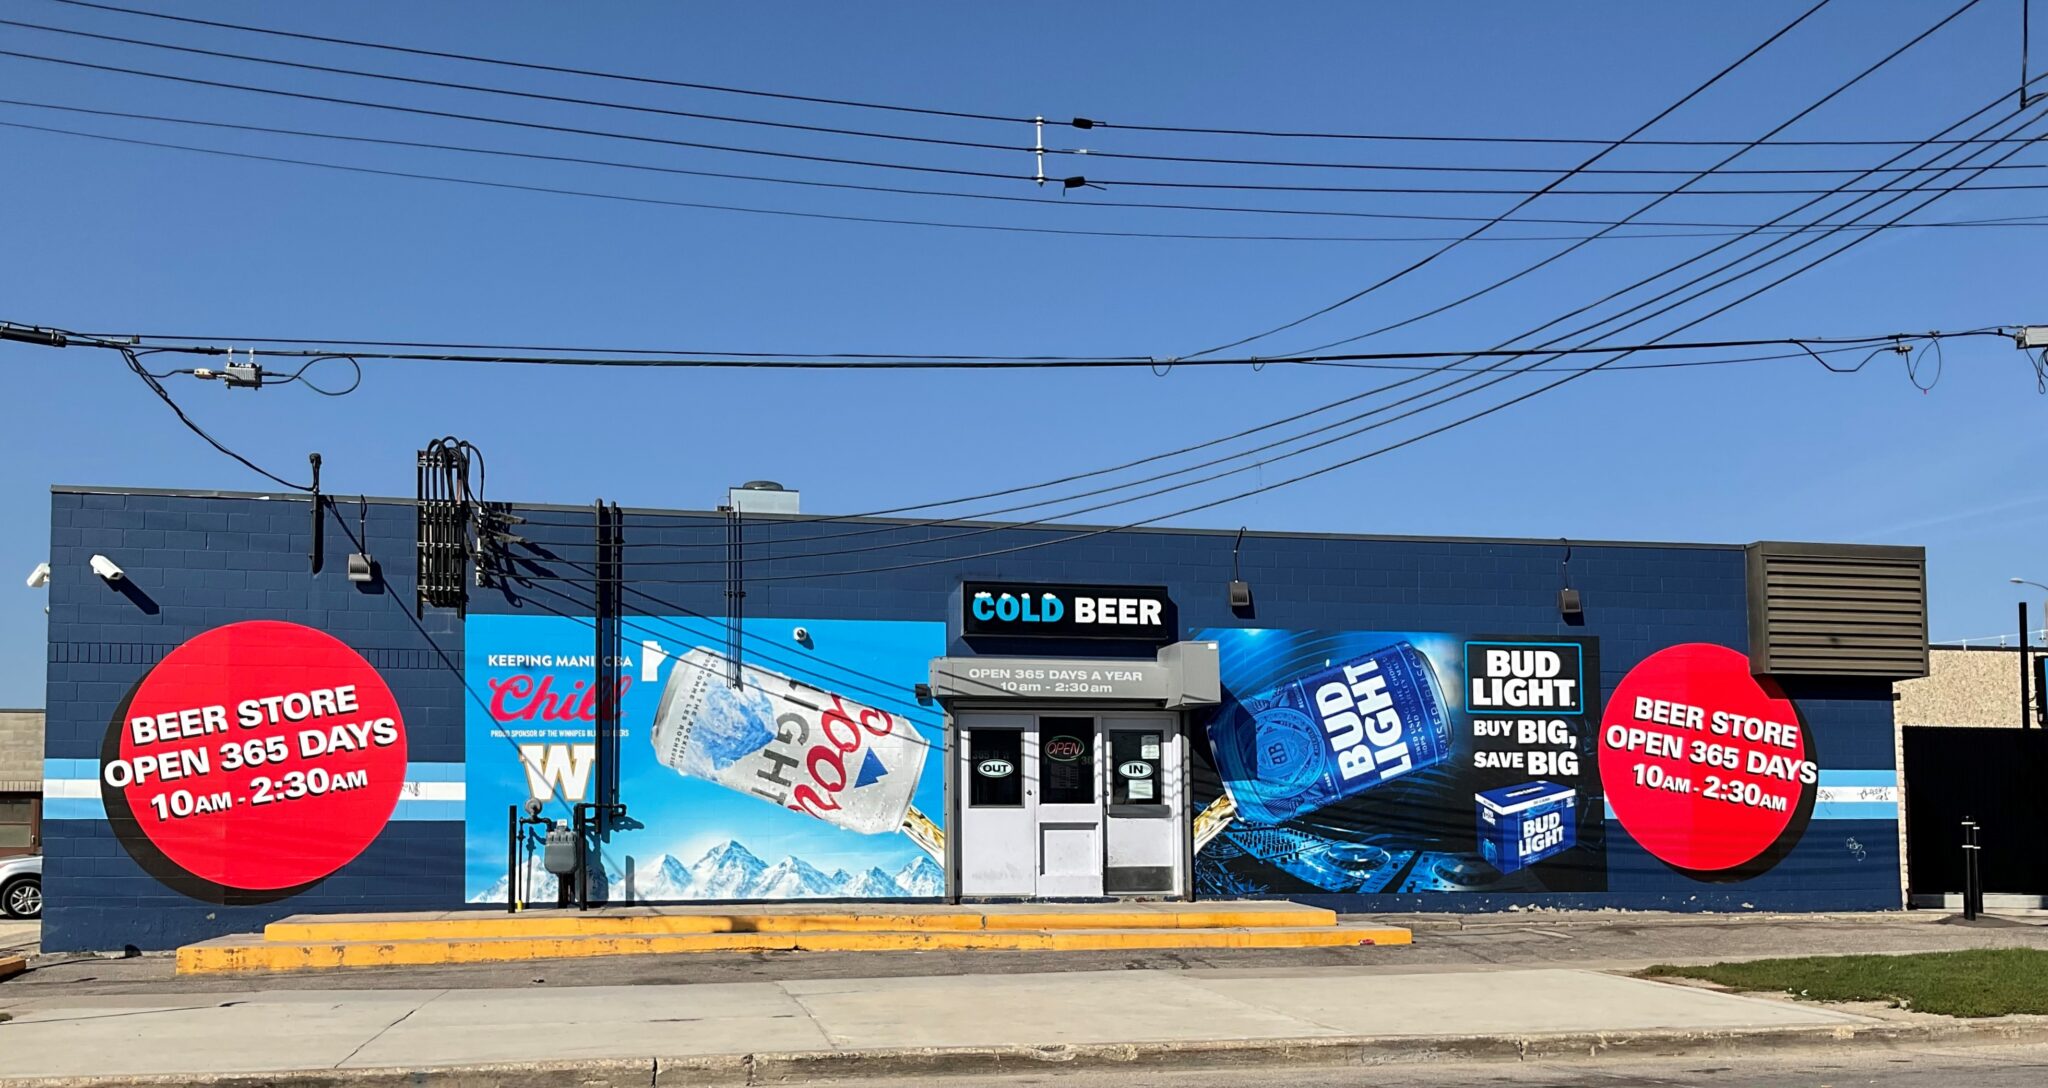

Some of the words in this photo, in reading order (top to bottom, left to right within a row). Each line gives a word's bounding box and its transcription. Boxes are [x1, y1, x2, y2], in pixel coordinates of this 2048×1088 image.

[972, 592, 1064, 622] COLD
[1074, 597, 1162, 625] BEER
[488, 655, 552, 667] KEEPING
[556, 655, 633, 667] MANIOBA
[969, 668, 1010, 679] OPEN
[1015, 669, 1045, 680] 365
[1049, 670, 1087, 681] DAYS
[1091, 671, 1101, 681] A
[1104, 671, 1143, 682] YEAR
[1486, 649, 1561, 678] BUD
[1055, 682, 1113, 693] 2:30am
[131, 705, 227, 746] BEER
[237, 685, 359, 729] STORE
[681, 703, 692, 721] LES
[691, 698, 702, 717] THE
[559, 730, 585, 738] WINNIPEG
[1316, 681, 1376, 781] BUD
[1473, 720, 1512, 737] BUY
[1517, 720, 1577, 749] BIG,
[1634, 696, 1703, 730] BEER
[1711, 710, 1798, 750] STORE
[103, 747, 210, 788] OPEN
[220, 735, 289, 772] 365
[299, 717, 398, 759] DAYS
[788, 692, 893, 819] Coor
[1047, 743, 1080, 755] OPEN
[1606, 725, 1682, 760] OPEN
[1690, 742, 1739, 770] 365
[1747, 752, 1818, 785] DAYS
[518, 743, 596, 803] W
[1129, 765, 1143, 774] IN
[1473, 753, 1523, 768] SAVE
[1527, 752, 1579, 776] BIG
[150, 788, 232, 820] 10AM
[249, 767, 368, 804] 2:30AM
[1632, 764, 1690, 793] 10AM
[1702, 776, 1787, 812] 2:30AM
[1523, 812, 1560, 838] BUD
[1519, 825, 1564, 857] LIGHT
